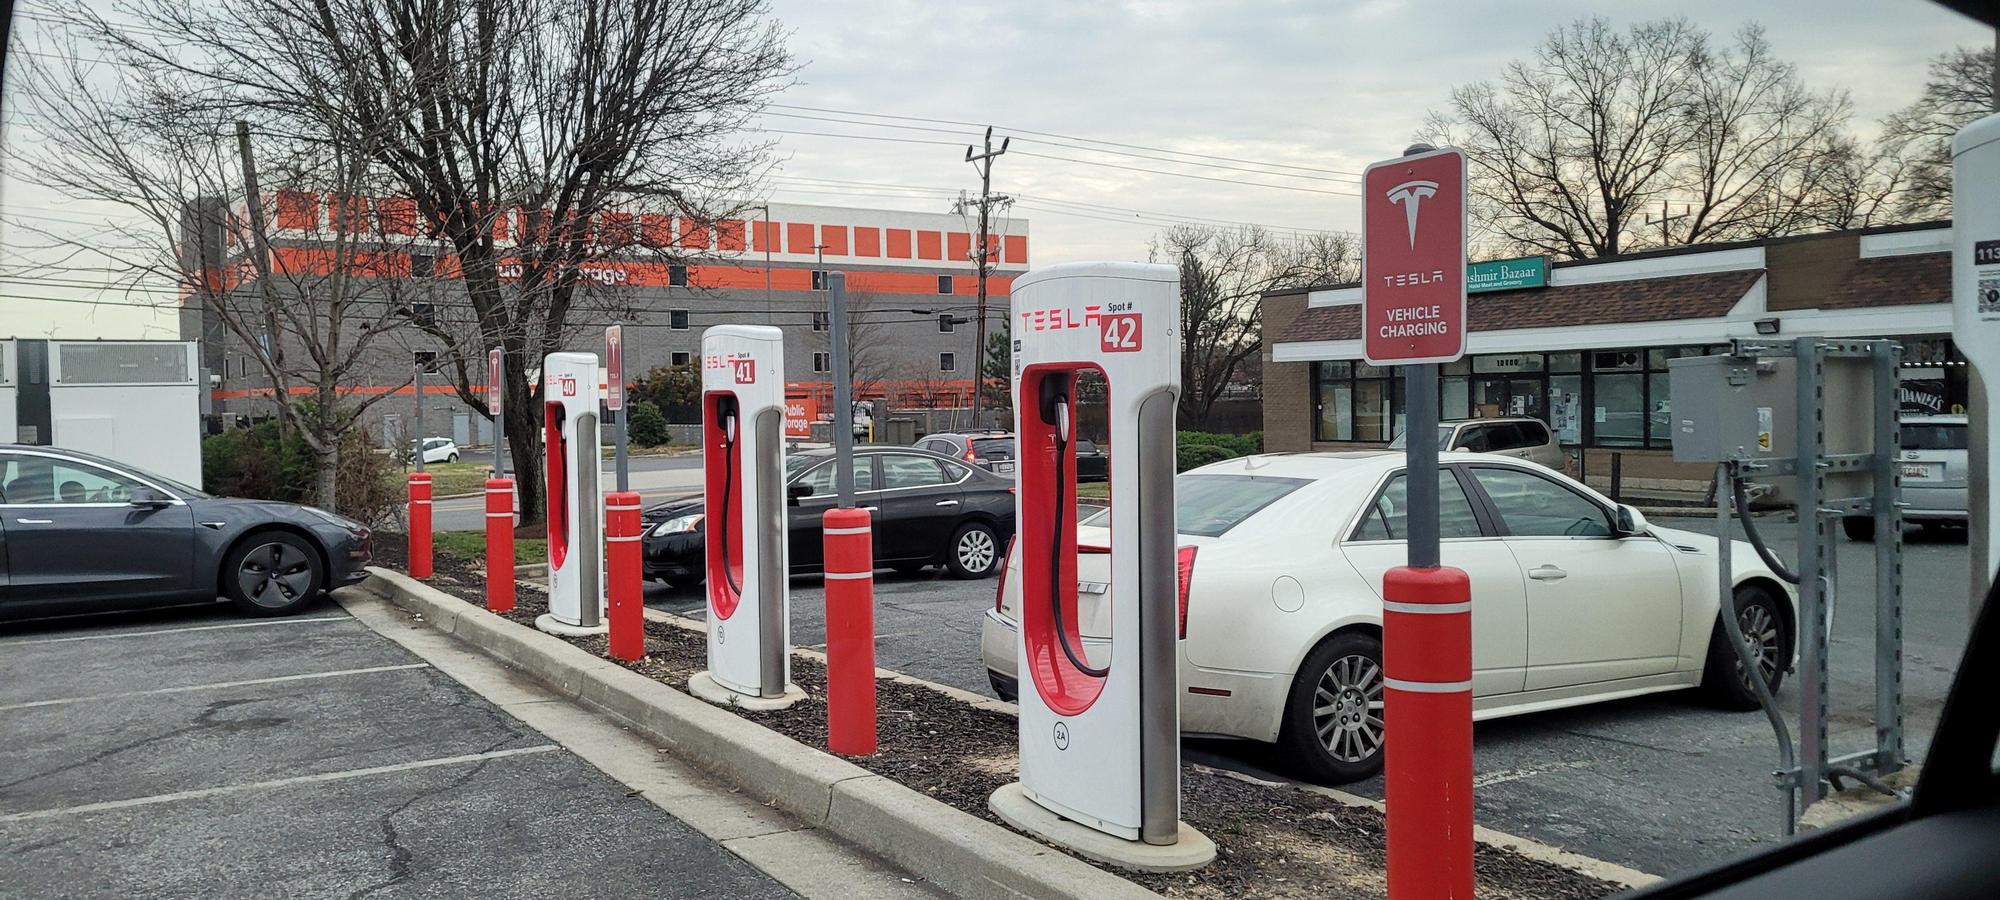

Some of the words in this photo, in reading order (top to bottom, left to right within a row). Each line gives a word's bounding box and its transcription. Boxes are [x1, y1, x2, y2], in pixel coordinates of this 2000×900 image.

[1384, 270, 1443, 288] TESLA
[1501, 265, 1536, 280] Bazaar
[1108, 302, 1125, 313] Spot
[1127, 301, 1133, 311] #
[1386, 305, 1441, 322] VEHICLE
[1022, 305, 1101, 332] TESLA
[1103, 317, 1137, 349] 42
[1380, 321, 1447, 339] CHARGING
[704, 353, 734, 369] ESLA
[736, 362, 753, 382] 41
[563, 380, 575, 396] 40
[1900, 387, 1945, 412] DANIEL'S
[1056, 730, 1066, 741] 2A
